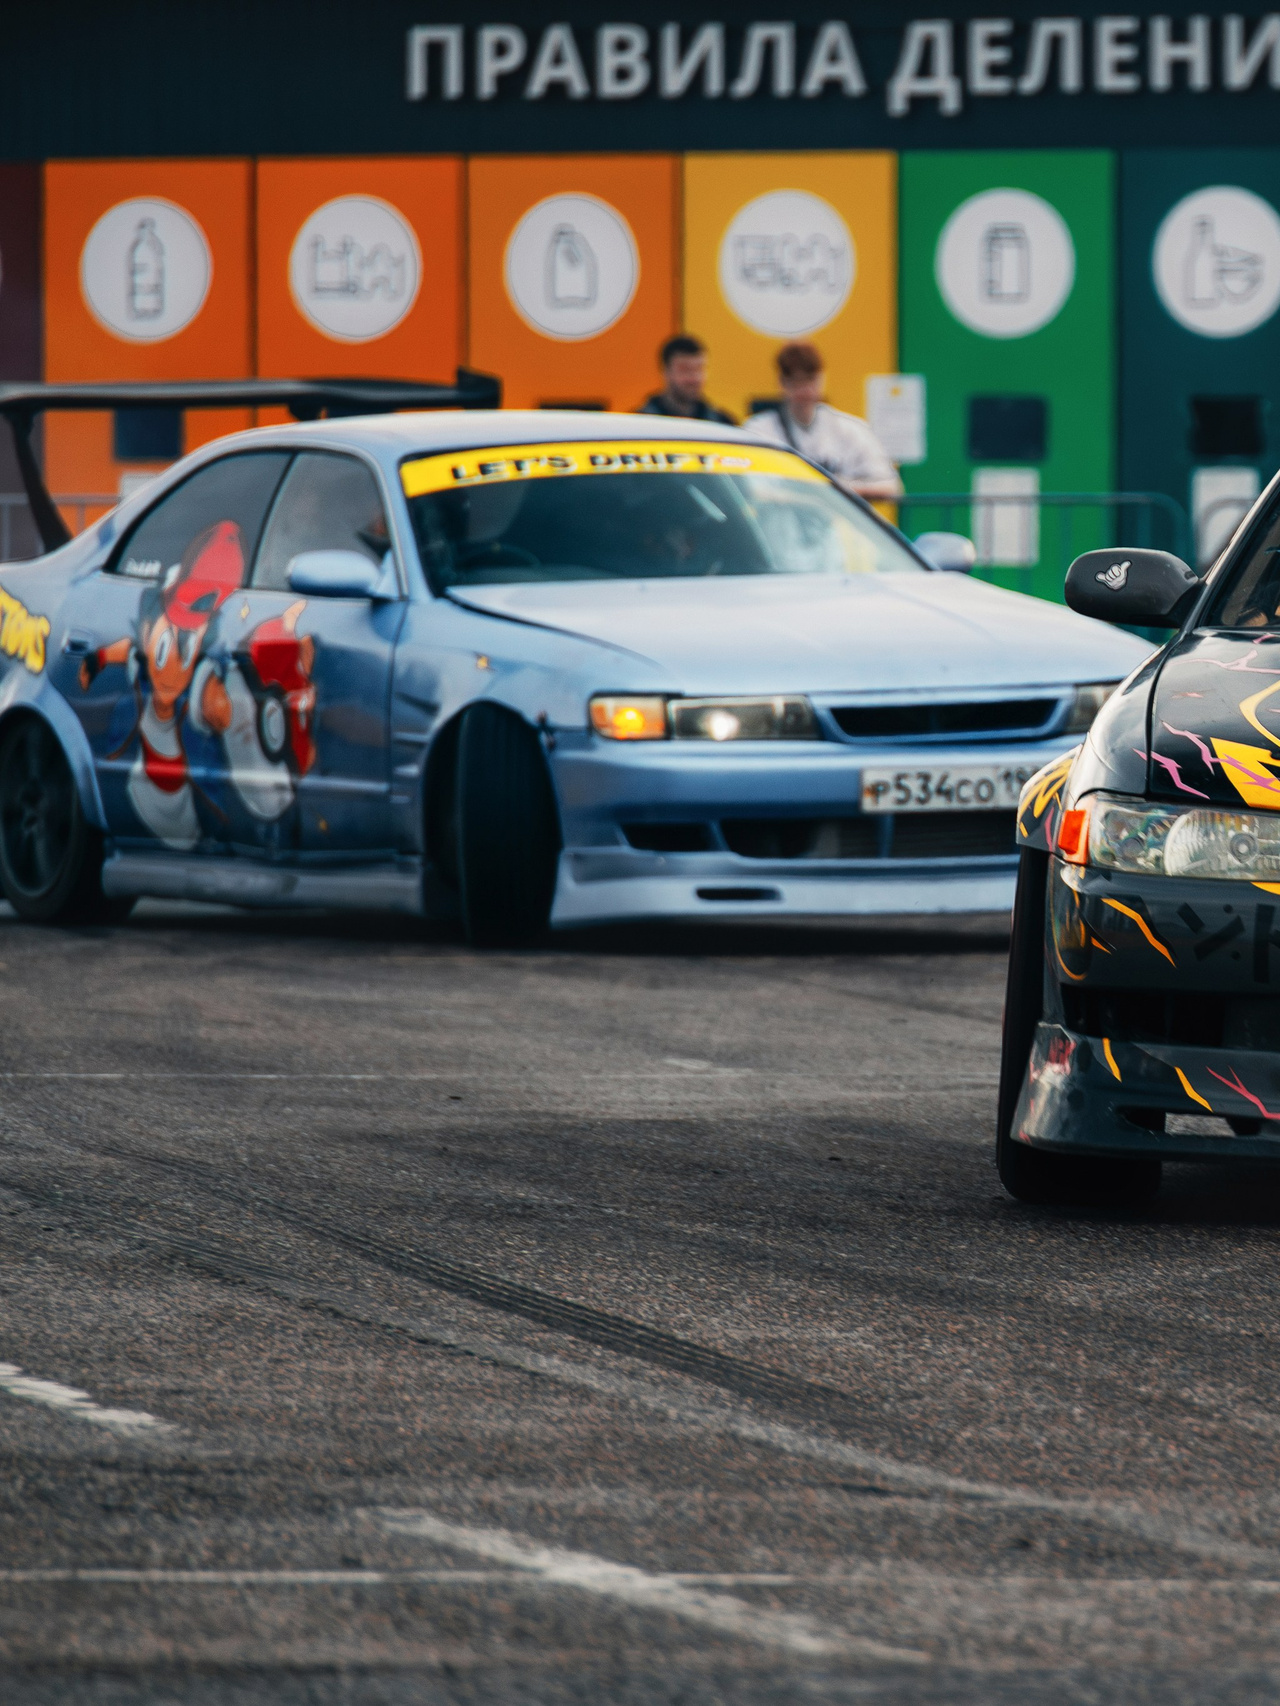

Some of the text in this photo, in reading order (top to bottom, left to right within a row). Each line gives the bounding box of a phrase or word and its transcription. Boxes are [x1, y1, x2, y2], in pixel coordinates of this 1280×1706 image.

[407, 23, 865, 101] ПРАВИЛА
[450, 455, 578, 484] LET'S
[588, 453, 718, 472] DRIFT
